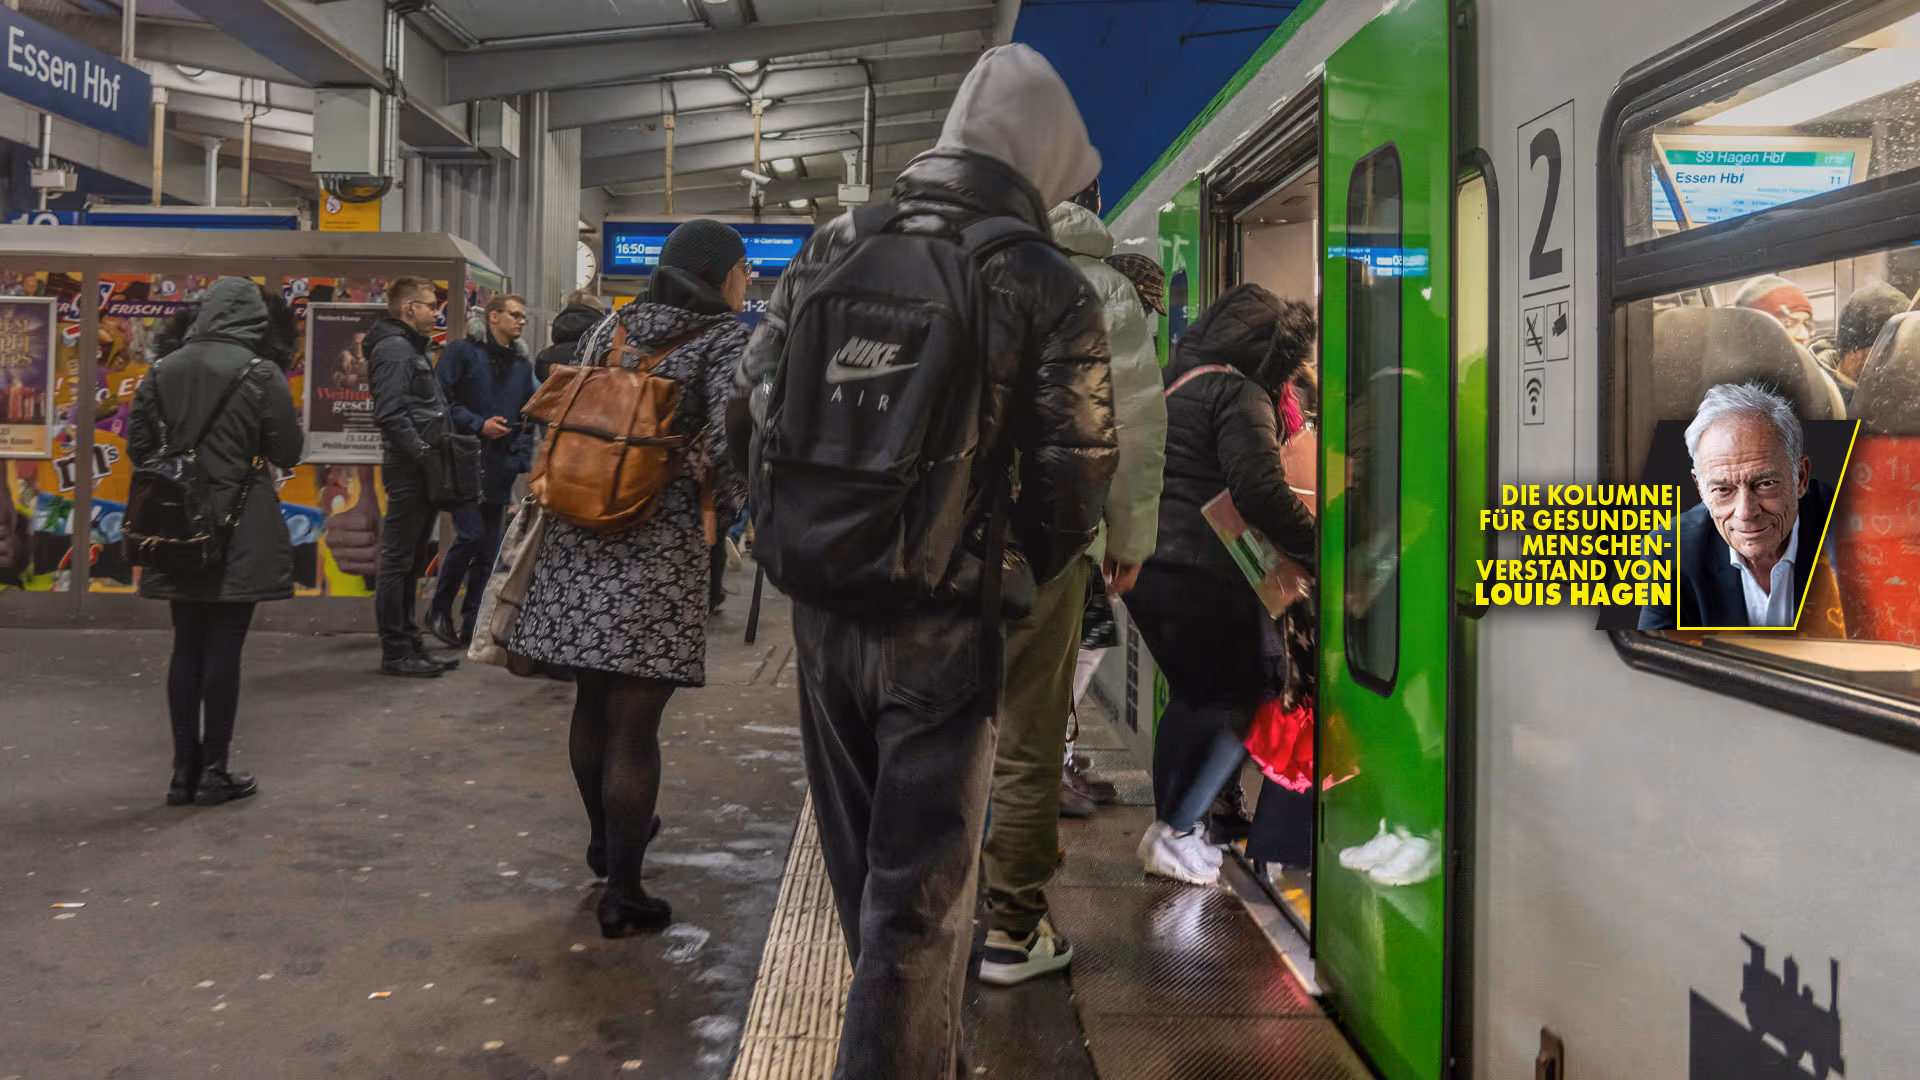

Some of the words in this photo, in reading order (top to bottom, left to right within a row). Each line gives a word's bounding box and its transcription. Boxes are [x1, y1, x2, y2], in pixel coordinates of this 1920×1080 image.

[8, 25, 76, 94] Essen
[83, 60, 121, 111] Hbf
[1696, 151, 1714, 163] S9
[1717, 152, 1759, 166] Hagen
[1762, 151, 1786, 163] Hbf
[1675, 171, 1716, 184] Essen
[1720, 171, 1744, 184] Hbf
[1529, 127, 1563, 280] 2
[616, 243, 645, 254] 16:50
[109, 303, 165, 316] FRISCH
[837, 336, 902, 368] NIKE
[831, 384, 889, 412] AIR
